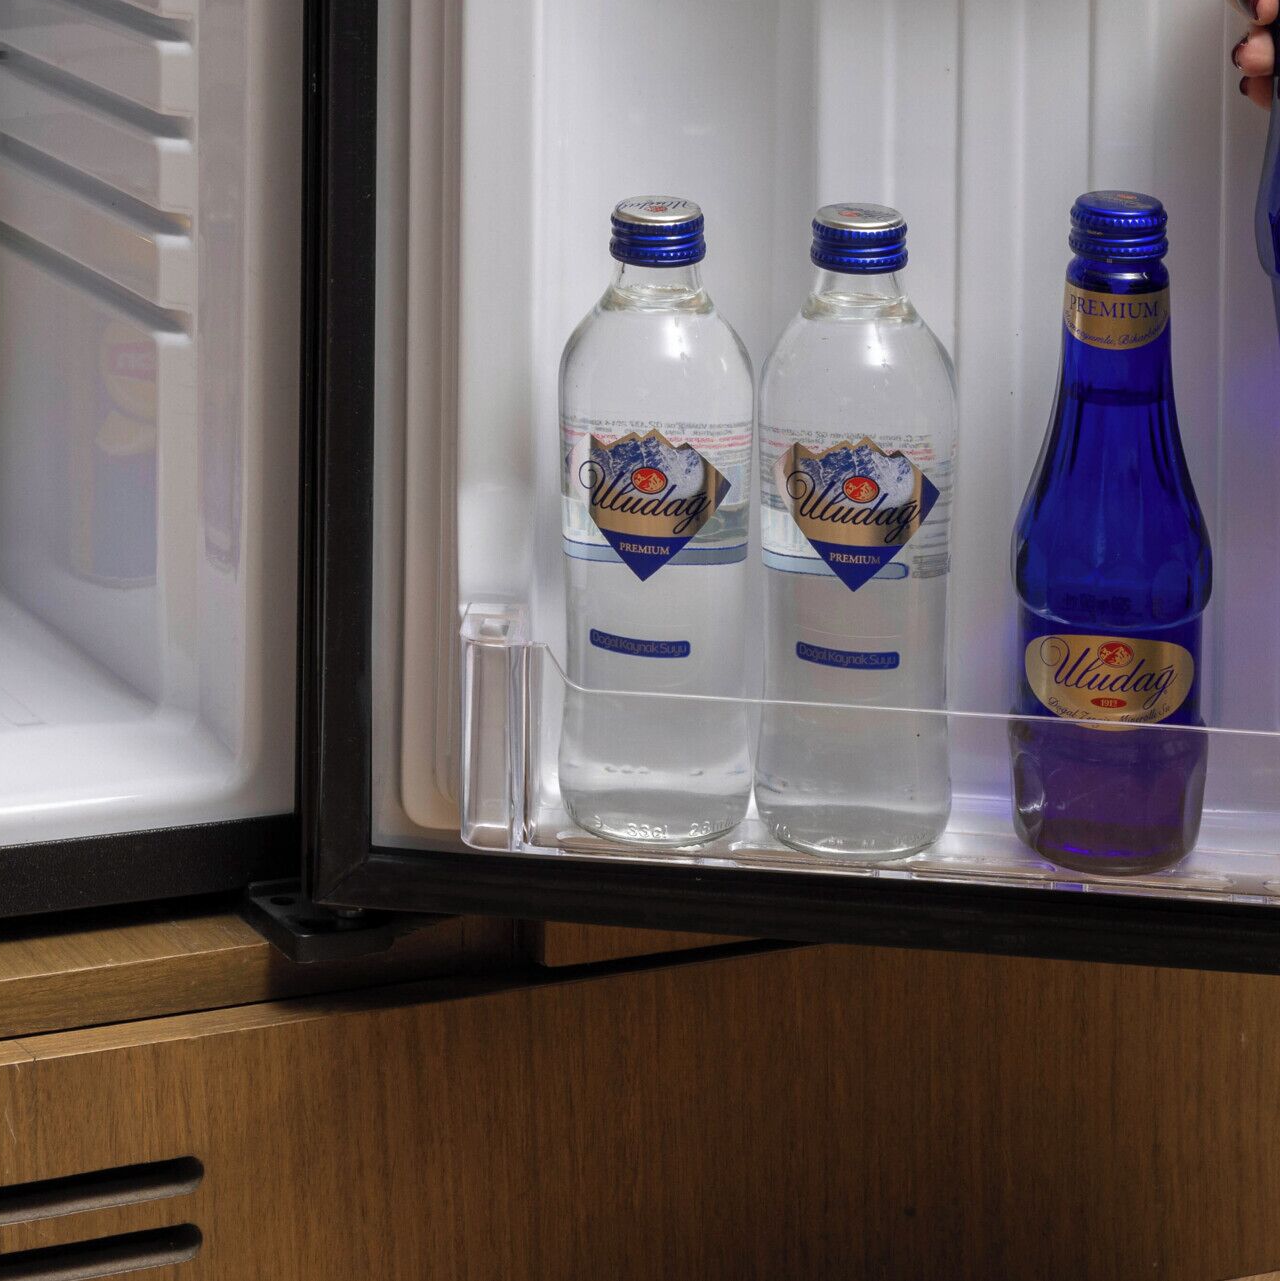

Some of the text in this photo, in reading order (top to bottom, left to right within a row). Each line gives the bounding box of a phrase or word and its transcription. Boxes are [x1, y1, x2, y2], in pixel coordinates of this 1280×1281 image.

[1070, 294, 1159, 319] PREMIUM
[579, 460, 711, 535] Uludağ
[786, 470, 920, 543] Uludağ
[620, 542, 669, 555] PREMIUM
[829, 552, 881, 565] PREMIUM
[1040, 636, 1178, 710] Uludağ
